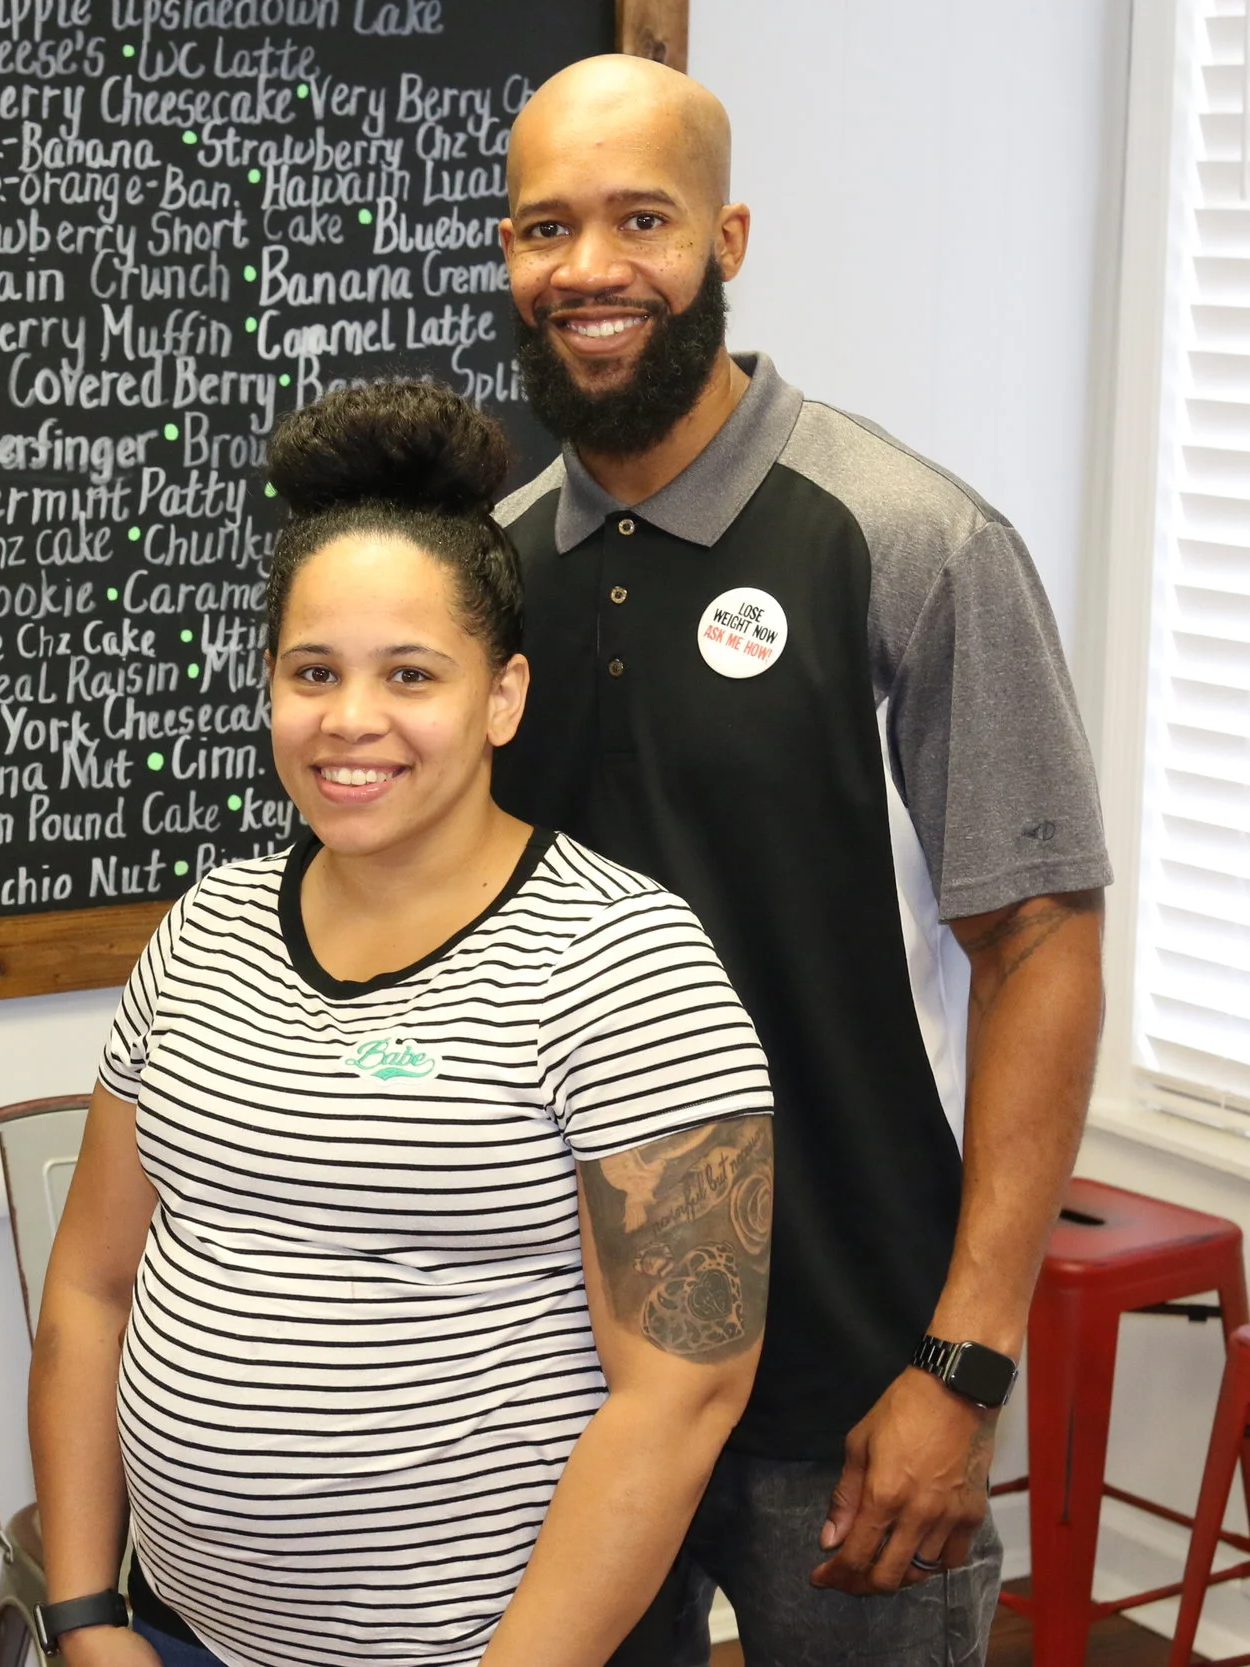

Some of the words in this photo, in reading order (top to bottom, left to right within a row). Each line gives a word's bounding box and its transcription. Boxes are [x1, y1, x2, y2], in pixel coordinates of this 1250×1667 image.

[353, 0, 445, 35] Cake
[214, 37, 319, 80] Latte
[101, 75, 296, 131] Cheesecake
[310, 75, 386, 138] Very
[397, 73, 492, 138] Berry
[198, 119, 403, 172] Strawberry
[416, 122, 468, 161] Chz
[148, 210, 250, 256] Short
[263, 205, 344, 246] Cake
[373, 197, 503, 255] Blueber
[90, 249, 231, 303] Crunch
[259, 245, 414, 306] Banana
[422, 249, 510, 297] Creme
[100, 304, 233, 363] Muffin
[406, 303, 497, 349] Latte
[9, 352, 170, 409] Covered
[173, 355, 277, 434] Berry
[139, 467, 247, 528] Patty
[713, 608, 752, 634] WEIGHT
[752, 624, 778, 644] NOW
[738, 602, 765, 622] LOSE
[17, 623, 72, 660] Chz
[84, 621, 156, 658] Cake
[703, 625, 726, 643] ASK
[725, 633, 744, 650] ME
[743, 640, 773, 663] HOW!
[67, 655, 179, 703] Raisin
[1, 703, 100, 755] York
[60, 740, 135, 791] Nut
[171, 735, 266, 781] Cinn.
[29, 794, 127, 843] Pound
[142, 789, 222, 836] Cake
[89, 849, 167, 896] Nut
[345, 1037, 435, 1080] Babe
